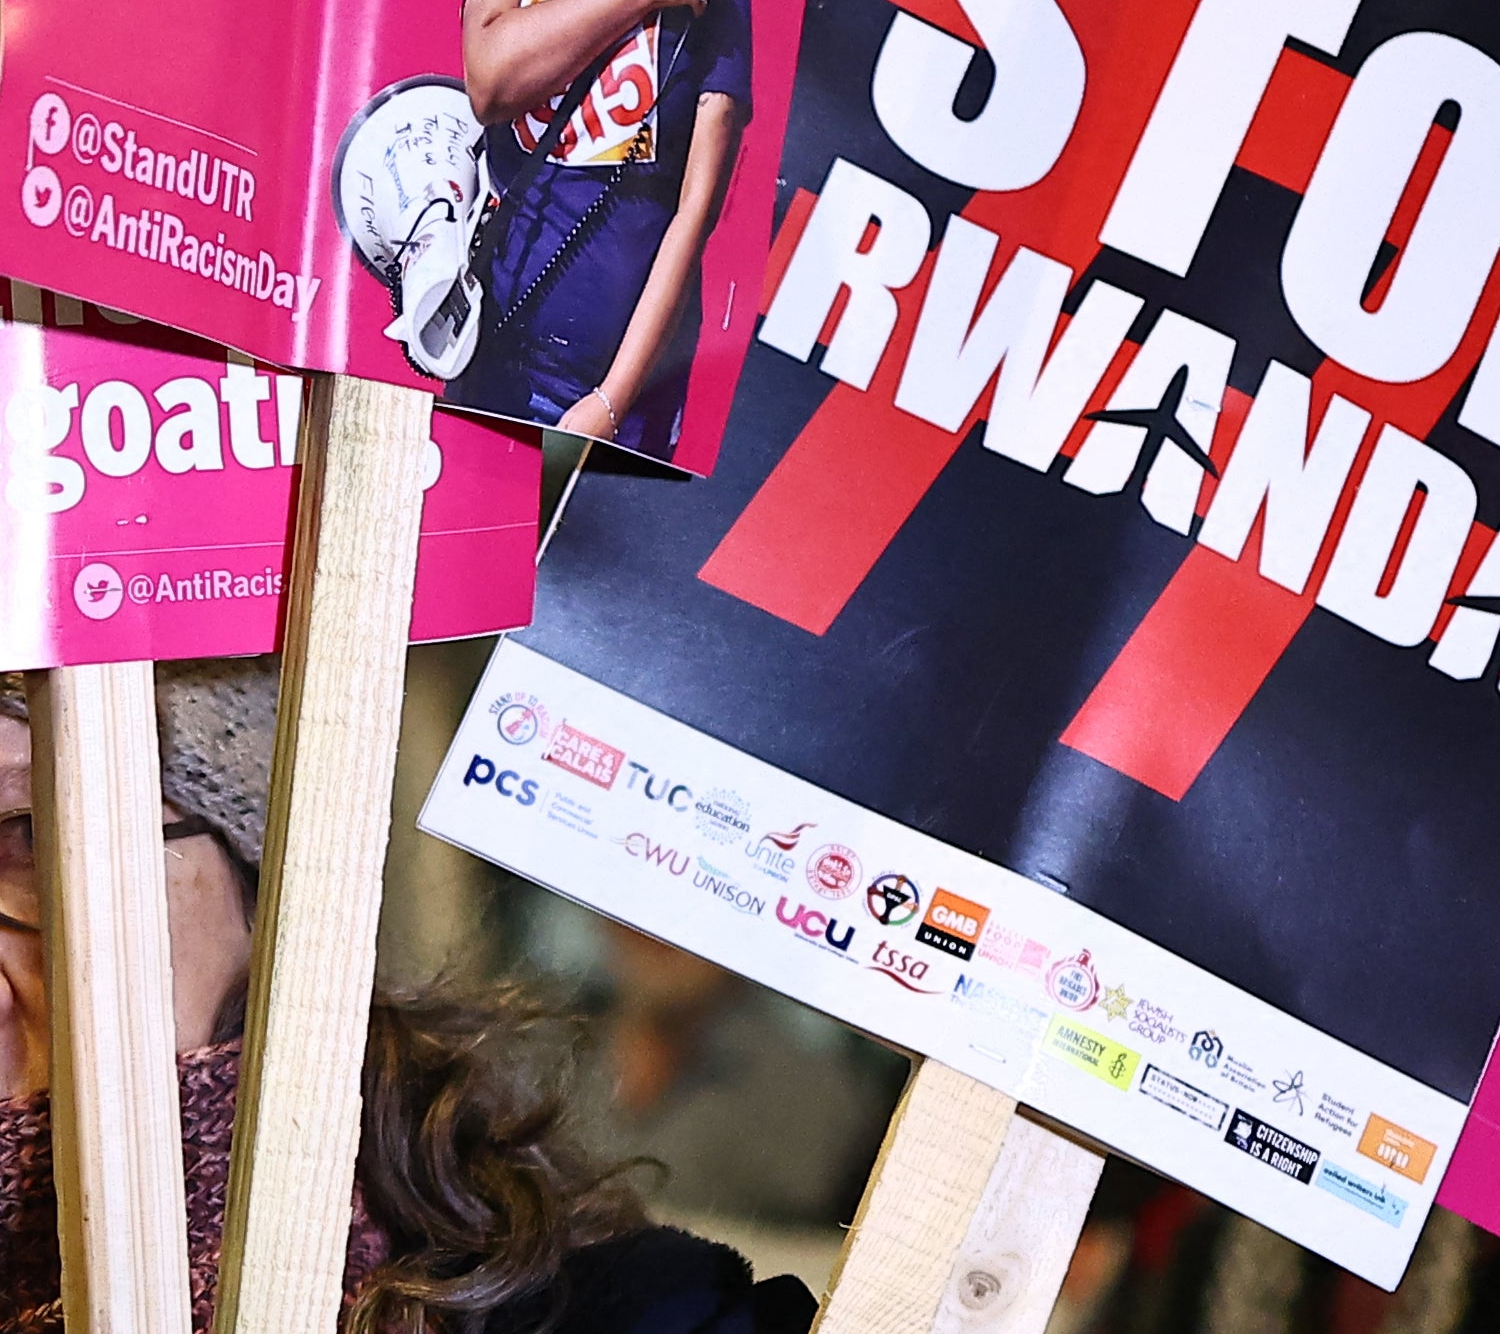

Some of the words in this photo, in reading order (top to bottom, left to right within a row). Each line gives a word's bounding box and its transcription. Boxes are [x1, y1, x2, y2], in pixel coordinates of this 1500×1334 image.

[72, 113, 256, 222] @StandUTR
[64, 185, 321, 322] @AntiRacismDay
[463, 754, 540, 806] pcs
[628, 760, 693, 812] TUC
[695, 801, 750, 833] education
[624, 832, 690, 876] CWU
[692, 870, 766, 916] UNISON
[931, 906, 979, 937] GMB
[872, 940, 930, 980] tssa
[924, 931, 968, 956] UNION
[1134, 1009, 1188, 1044] SOCIALISTS
[1137, 998, 1174, 1023] JEWISH
[1057, 1025, 1107, 1057] AMNESTY
[1129, 1020, 1166, 1044] GROUP
[1250, 1140, 1261, 1157] IS
[1261, 1147, 1270, 1163] A
[1270, 1151, 1304, 1178] RIGHT
[1255, 1124, 1319, 1166] CITIZENSHIP
